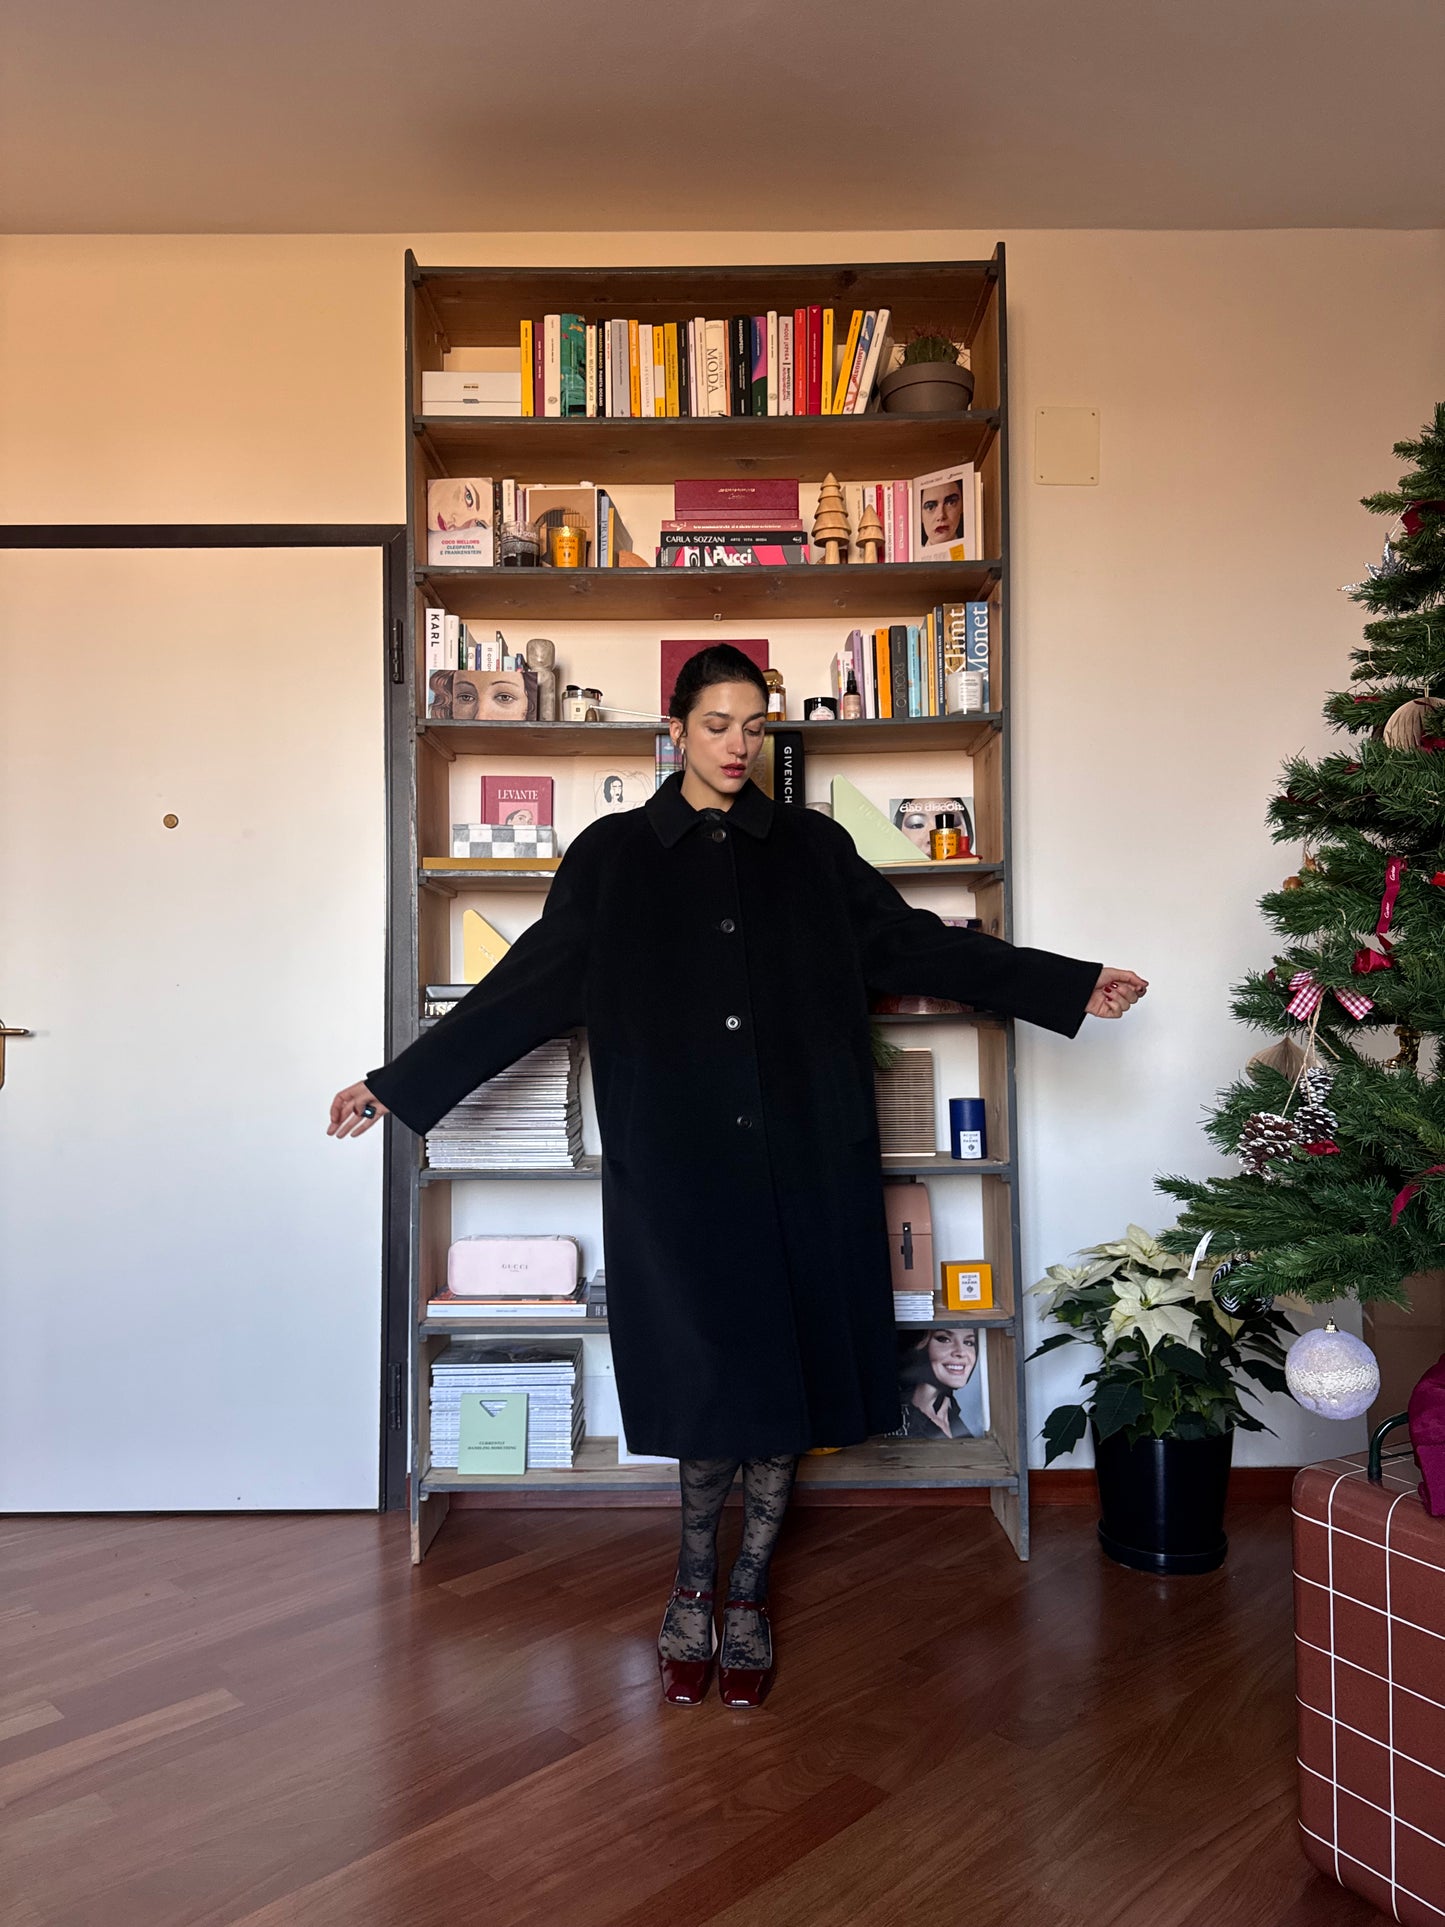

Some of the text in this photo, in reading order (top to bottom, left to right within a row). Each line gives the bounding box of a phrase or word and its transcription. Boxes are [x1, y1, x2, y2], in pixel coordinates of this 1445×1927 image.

[706, 348, 720, 394] MODA
[713, 548, 752, 564] Pucci
[430, 614, 440, 648] KARL
[944, 608, 966, 676] Klimt
[968, 606, 989, 682] Monet
[498, 789, 539, 800] LEVANTE
[783, 746, 793, 804] GIVENCH
